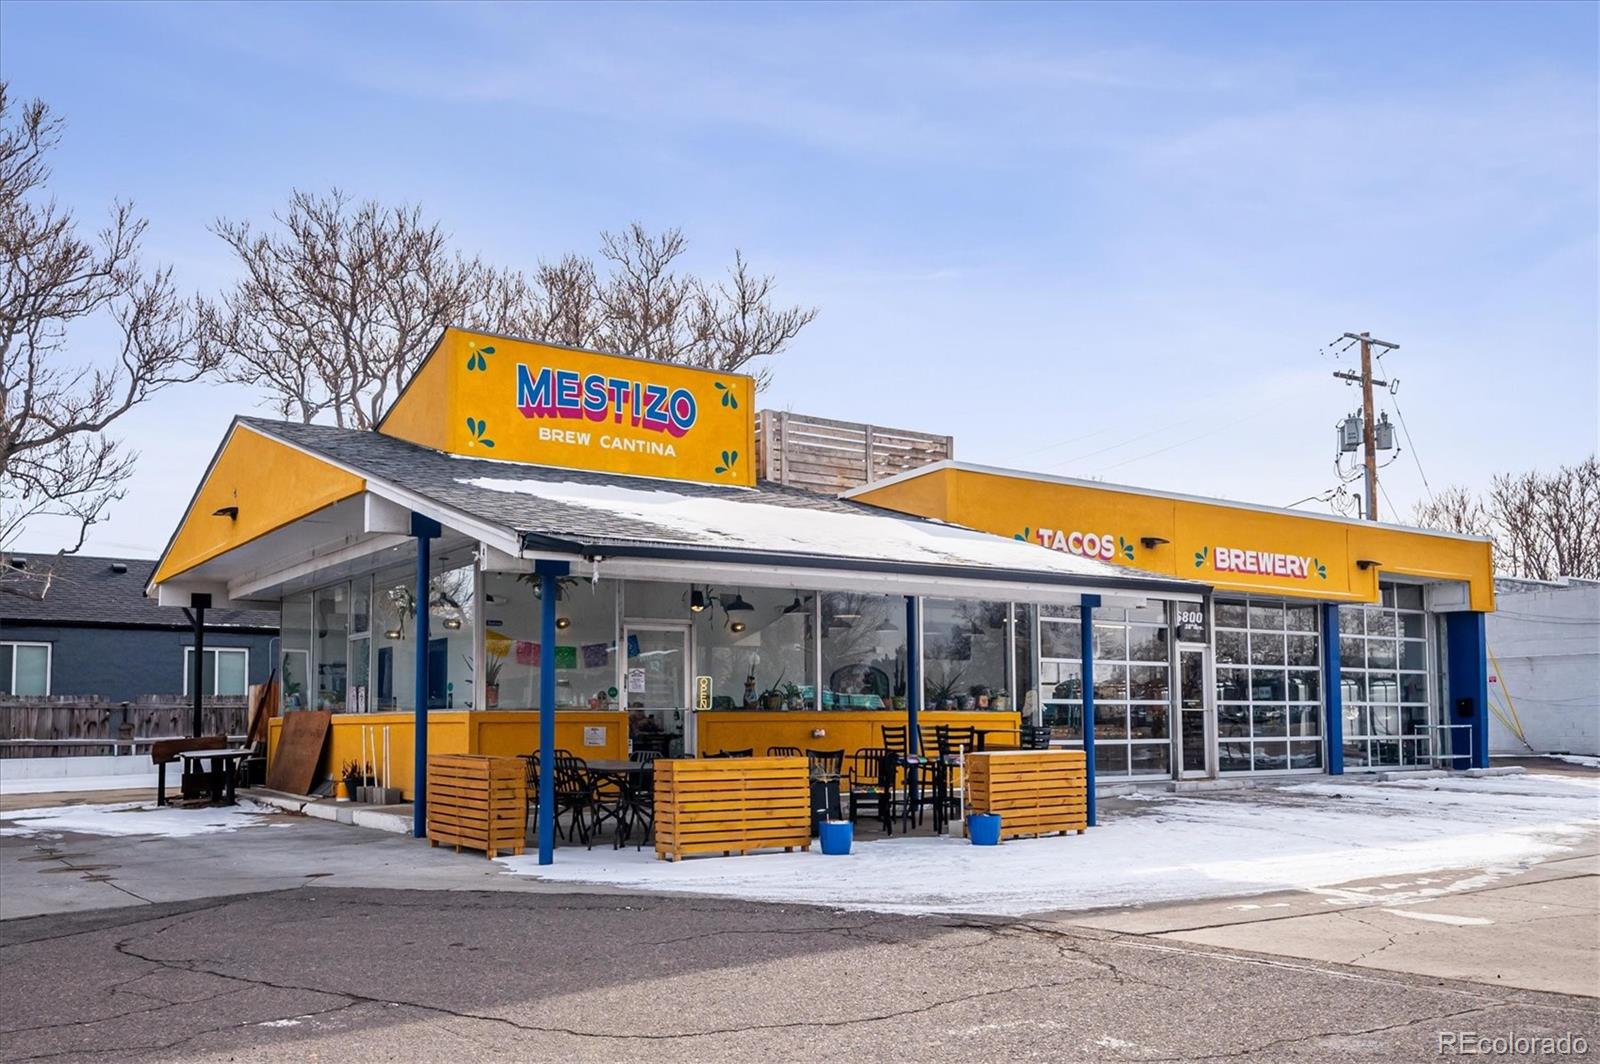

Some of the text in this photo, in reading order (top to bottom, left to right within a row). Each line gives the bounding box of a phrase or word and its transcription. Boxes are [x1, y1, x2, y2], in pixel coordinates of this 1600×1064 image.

[516, 363, 697, 437] MESTIZO
[539, 428, 677, 457] BREW CANTINA
[1037, 528, 1115, 560] TACOS
[1214, 546, 1311, 578] BREWERY
[700, 678, 708, 709] OPEN
